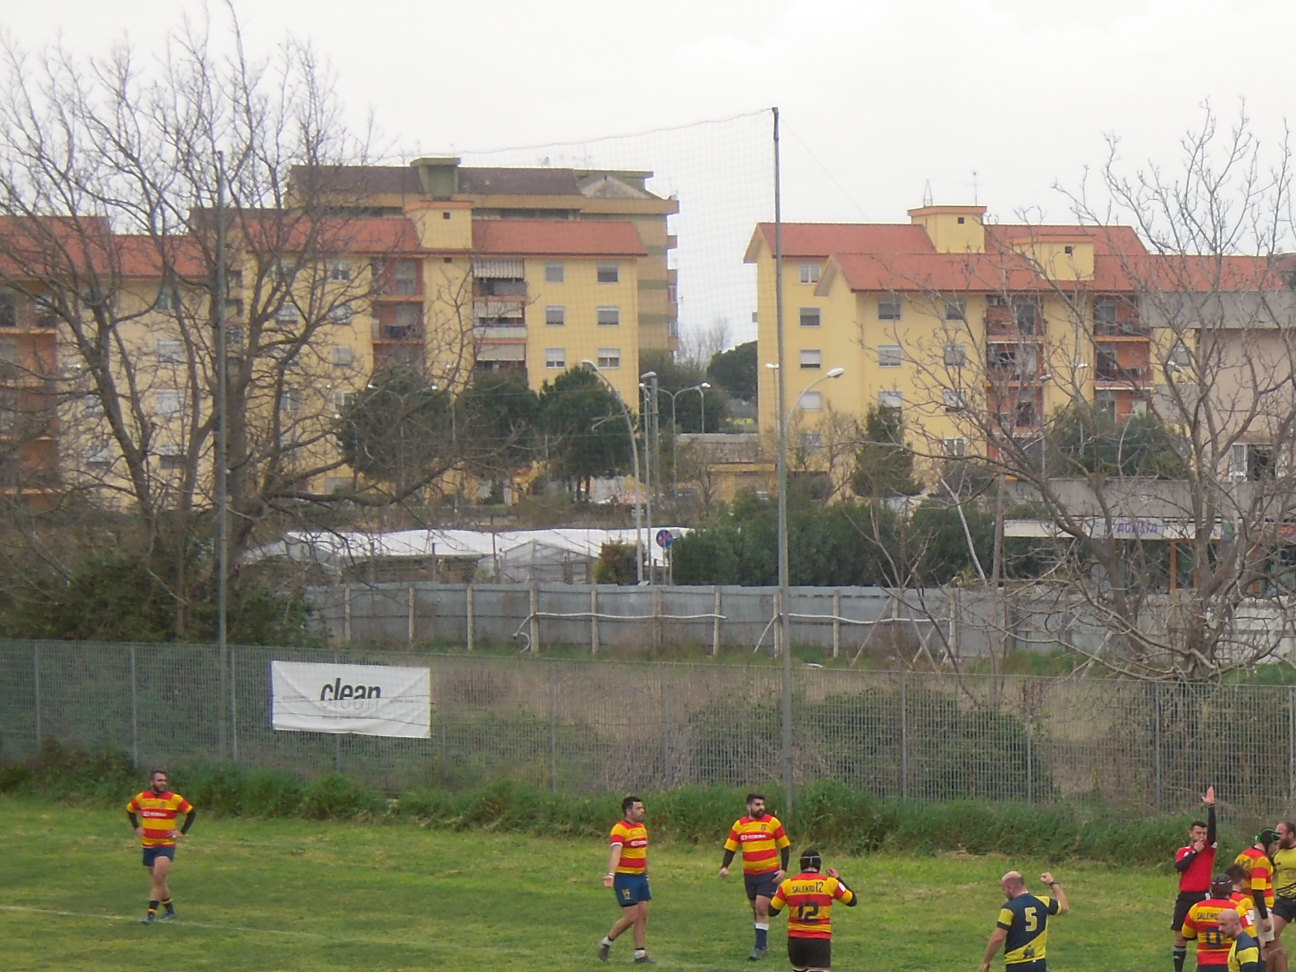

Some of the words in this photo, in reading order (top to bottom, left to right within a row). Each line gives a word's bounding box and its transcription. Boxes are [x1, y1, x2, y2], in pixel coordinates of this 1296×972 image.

[320, 678, 381, 701] clean
[798, 901, 820, 922] 12
[1024, 906, 1038, 932] 5
